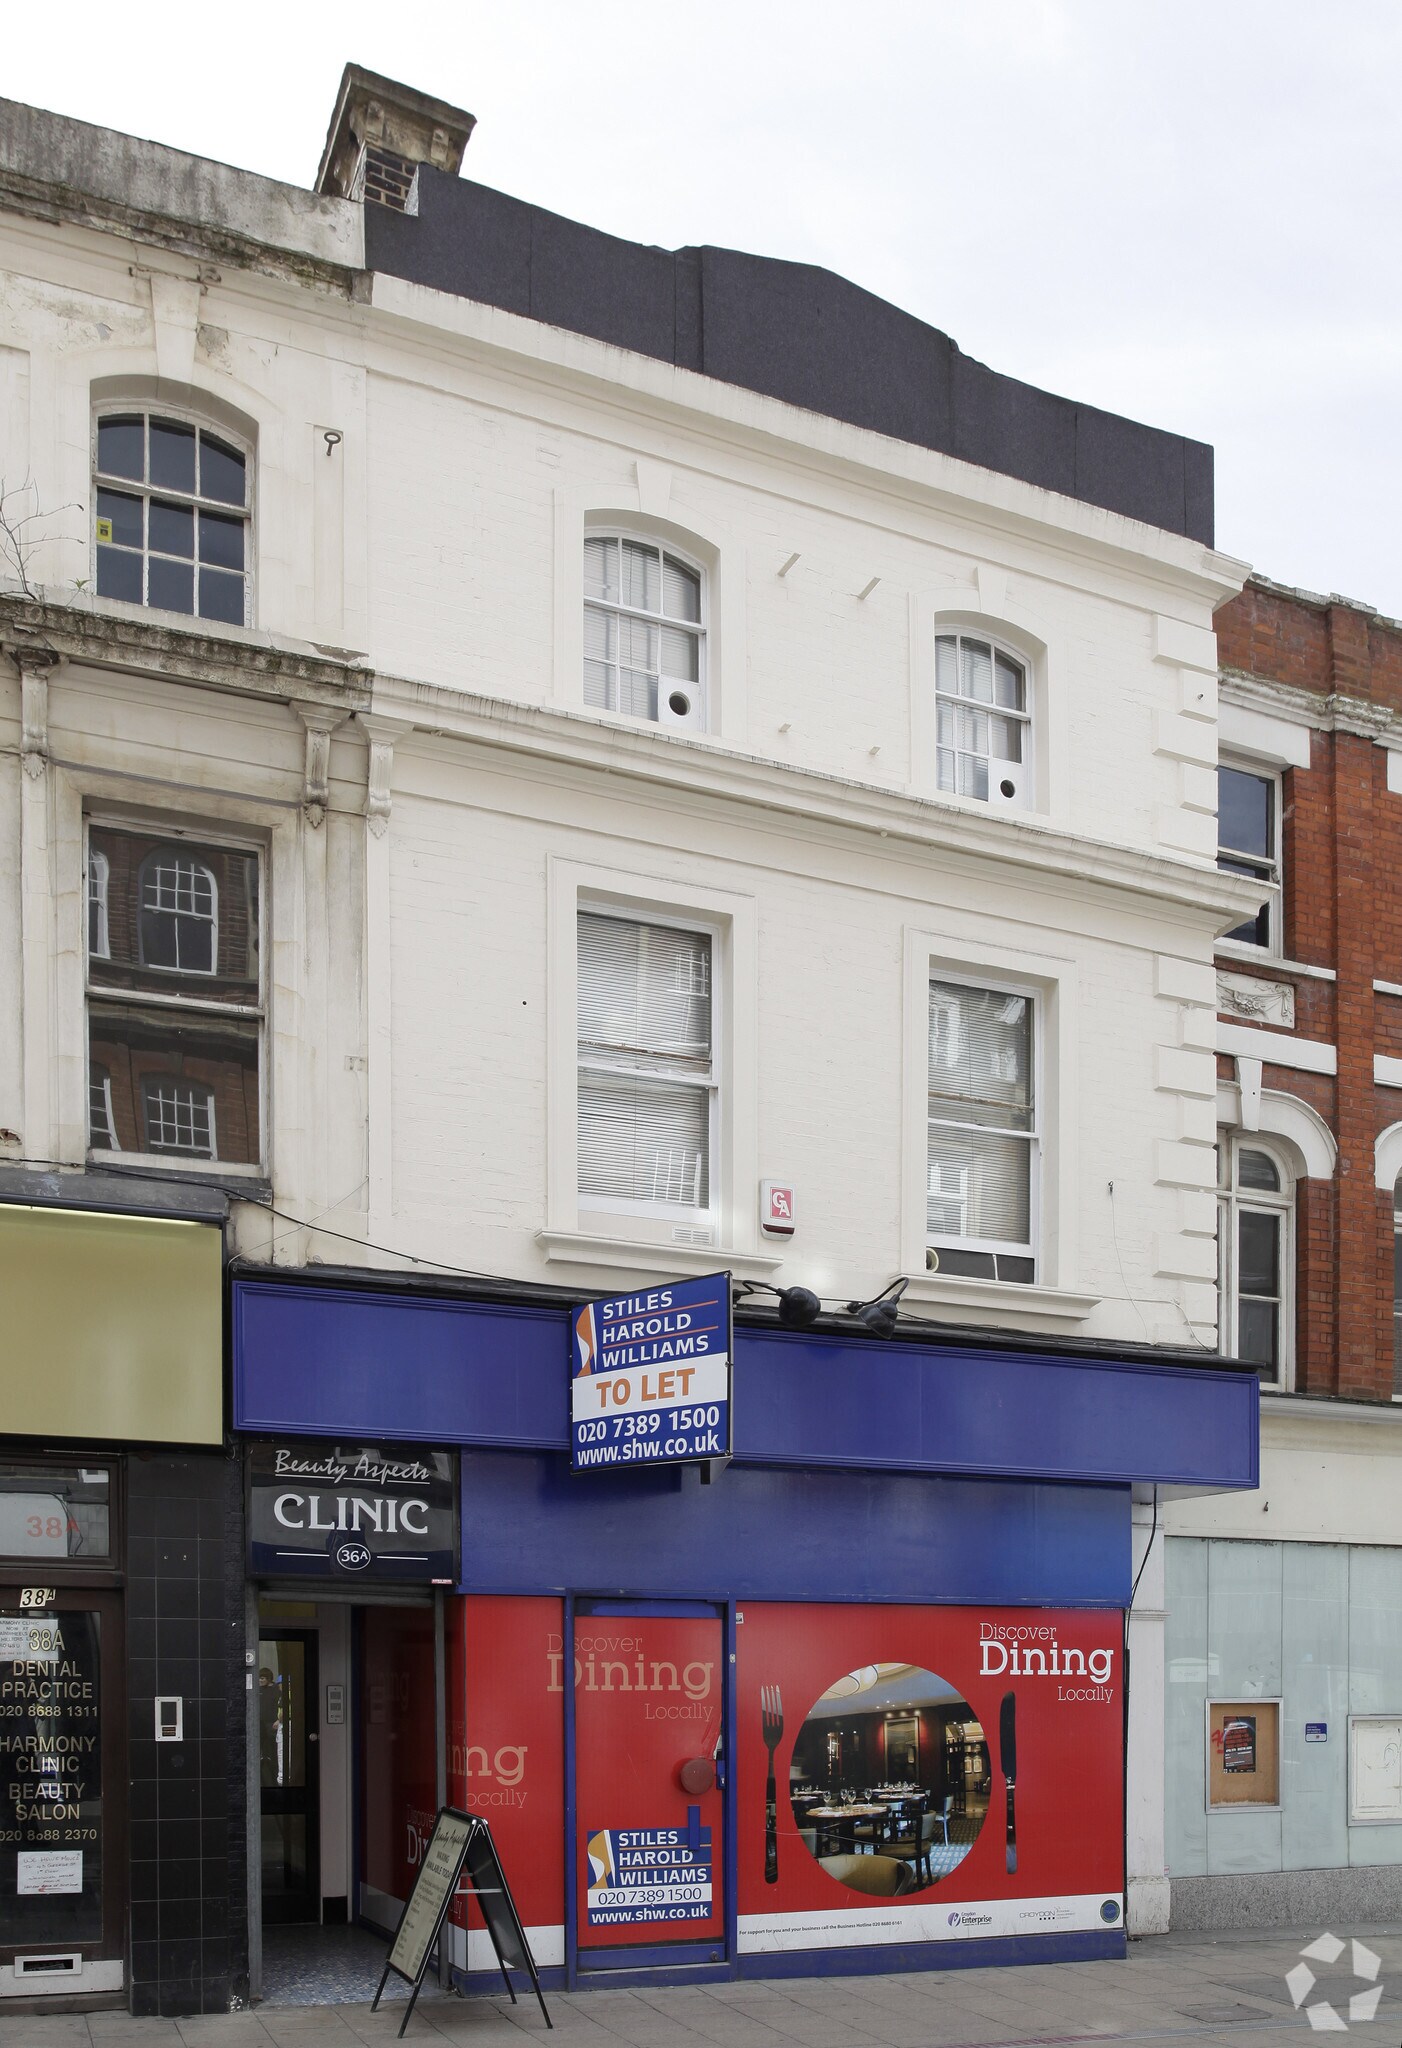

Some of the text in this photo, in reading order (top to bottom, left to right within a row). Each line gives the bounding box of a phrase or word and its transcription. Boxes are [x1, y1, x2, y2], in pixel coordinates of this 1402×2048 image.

[603, 1291, 673, 1319] STILES
[602, 1313, 691, 1344] HAROLD
[602, 1335, 708, 1368] WILLIAMS
[596, 1368, 695, 1408] TO LET
[578, 1406, 719, 1443] 020 7389 1500
[578, 1430, 719, 1465] www.shw.co.uk
[275, 1450, 430, 1484] Beauty Aspects
[274, 1494, 429, 1534] CLINIC
[27, 1516, 80, 1538] 38A
[341, 1550, 368, 1562] 36A
[22, 1589, 55, 1606] 38A
[29, 1629, 65, 1651] 38A
[980, 1623, 1056, 1640] Discover
[547, 1634, 642, 1652] Dscover
[14, 1661, 81, 1676] DENTAL
[980, 1641, 1114, 1684] Dining
[2, 1682, 92, 1698] PRACTICE
[1058, 1686, 1113, 1703] Locally
[28, 1706, 61, 1717] 8688
[67, 1706, 98, 1716] 1311
[645, 1703, 713, 1722] Locally
[0, 1736, 96, 1752] HARMONY
[16, 1756, 80, 1772] CLINIC
[9, 1783, 85, 1799] BEAUTY
[467, 1789, 527, 1808] ocally
[16, 1804, 80, 1820] SALON
[65, 1829, 97, 1840] 2370
[619, 1831, 678, 1846] STILES
[620, 1850, 693, 1866] HAROLD
[620, 1868, 707, 1885] WILLIAMS
[598, 1888, 701, 1905] 020 7389 1500
[592, 1905, 708, 1923] www.shw.co.uk
[962, 1915, 992, 1925] Enterprise
